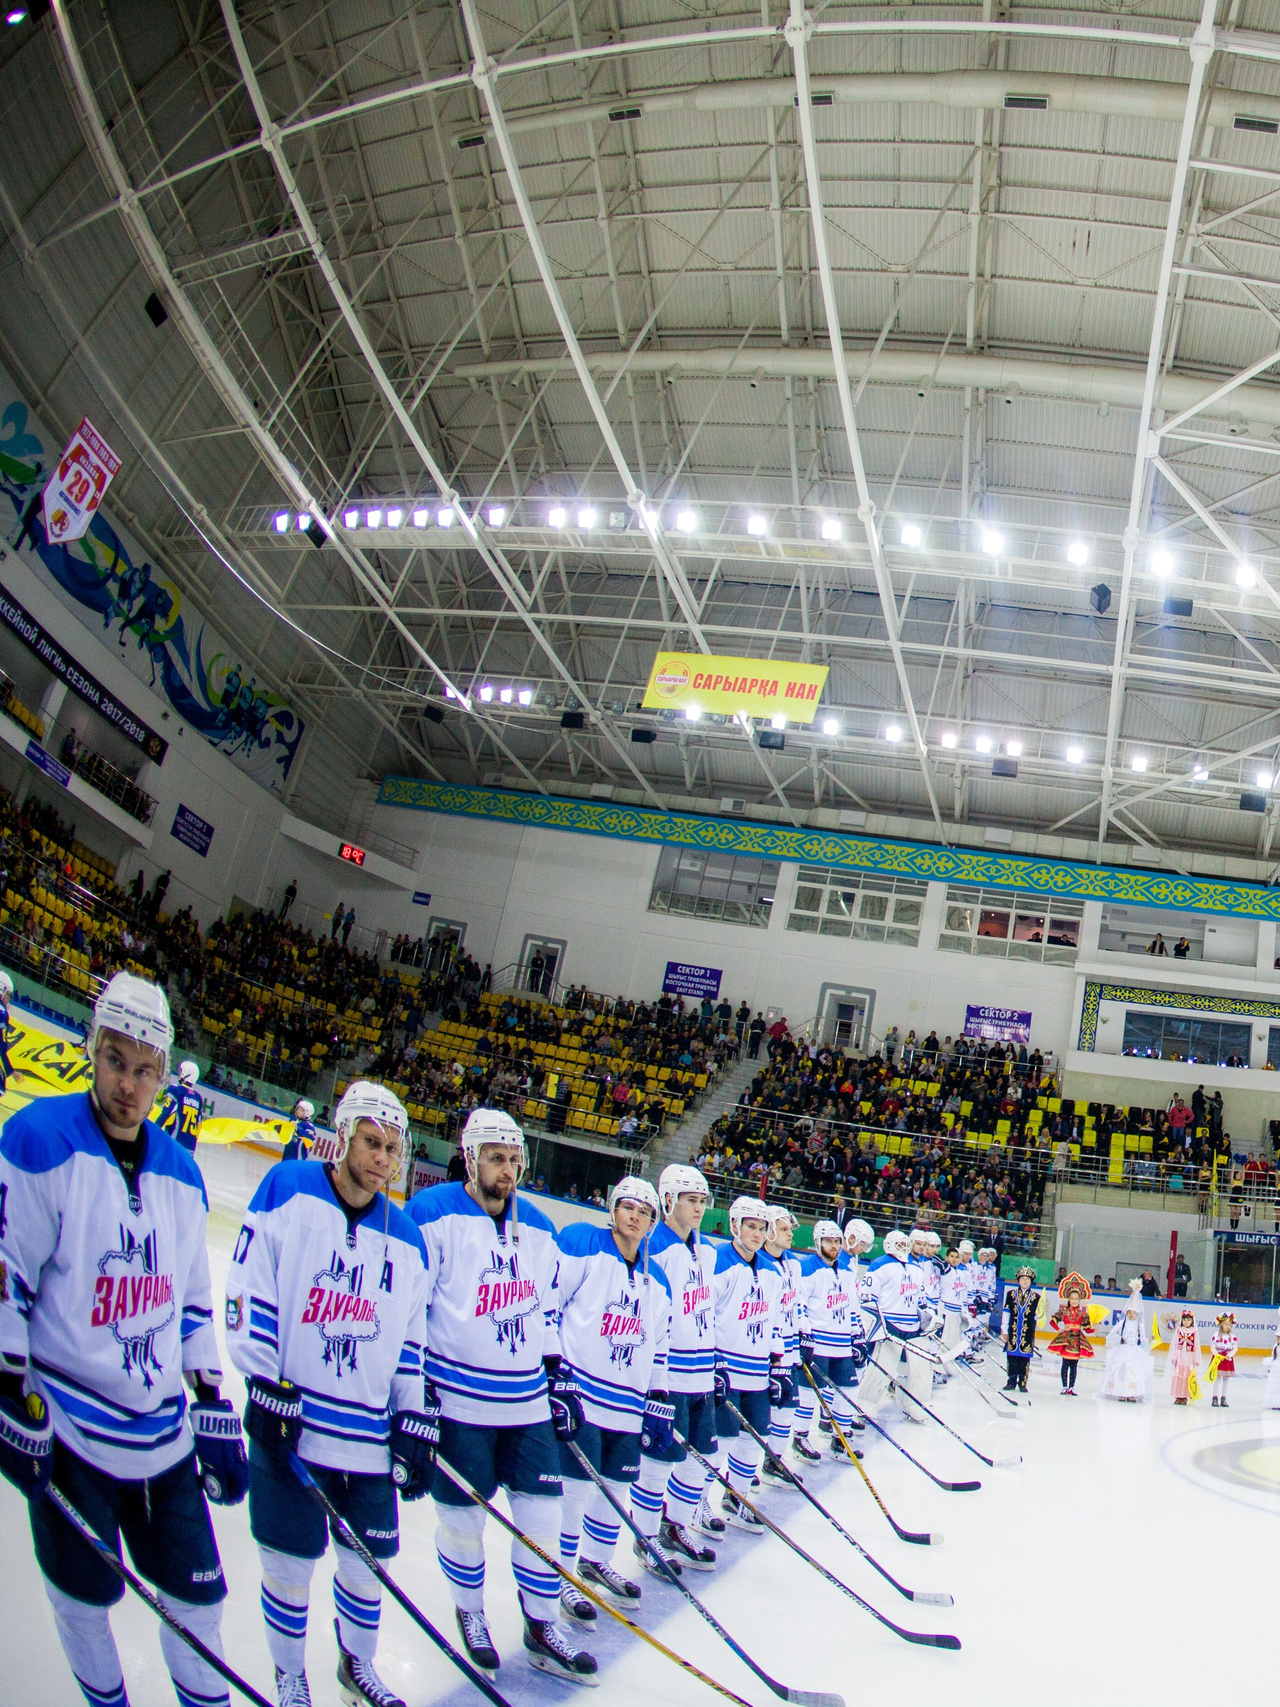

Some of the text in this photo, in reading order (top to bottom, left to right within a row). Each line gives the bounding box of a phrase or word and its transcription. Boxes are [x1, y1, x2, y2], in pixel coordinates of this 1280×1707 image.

[65, 469, 91, 504] 29
[692, 673, 818, 701] САРЫАРҚА НАН
[66, 668, 100, 705] СЕЗОНА
[100, 698, 146, 742] 2017/2018
[677, 966, 705, 977] СЕКТОР
[124, 1008, 152, 1023] BAUER
[979, 1008, 1019, 1020] СЕКТОР 2
[181, 1105, 201, 1136] 75
[1235, 1233, 1277, 1245] ШЫҒЫС
[91, 1273, 173, 1328] ЗАУРАЛЬЕ
[301, 1286, 378, 1325] ЗАУРАЛЬЕ
[475, 1279, 536, 1318] ЗАУРАЛЬЕ
[1235, 1323, 1265, 1332] ХОККЕЯ
[683, 1590, 730, 1641] NEXUS
